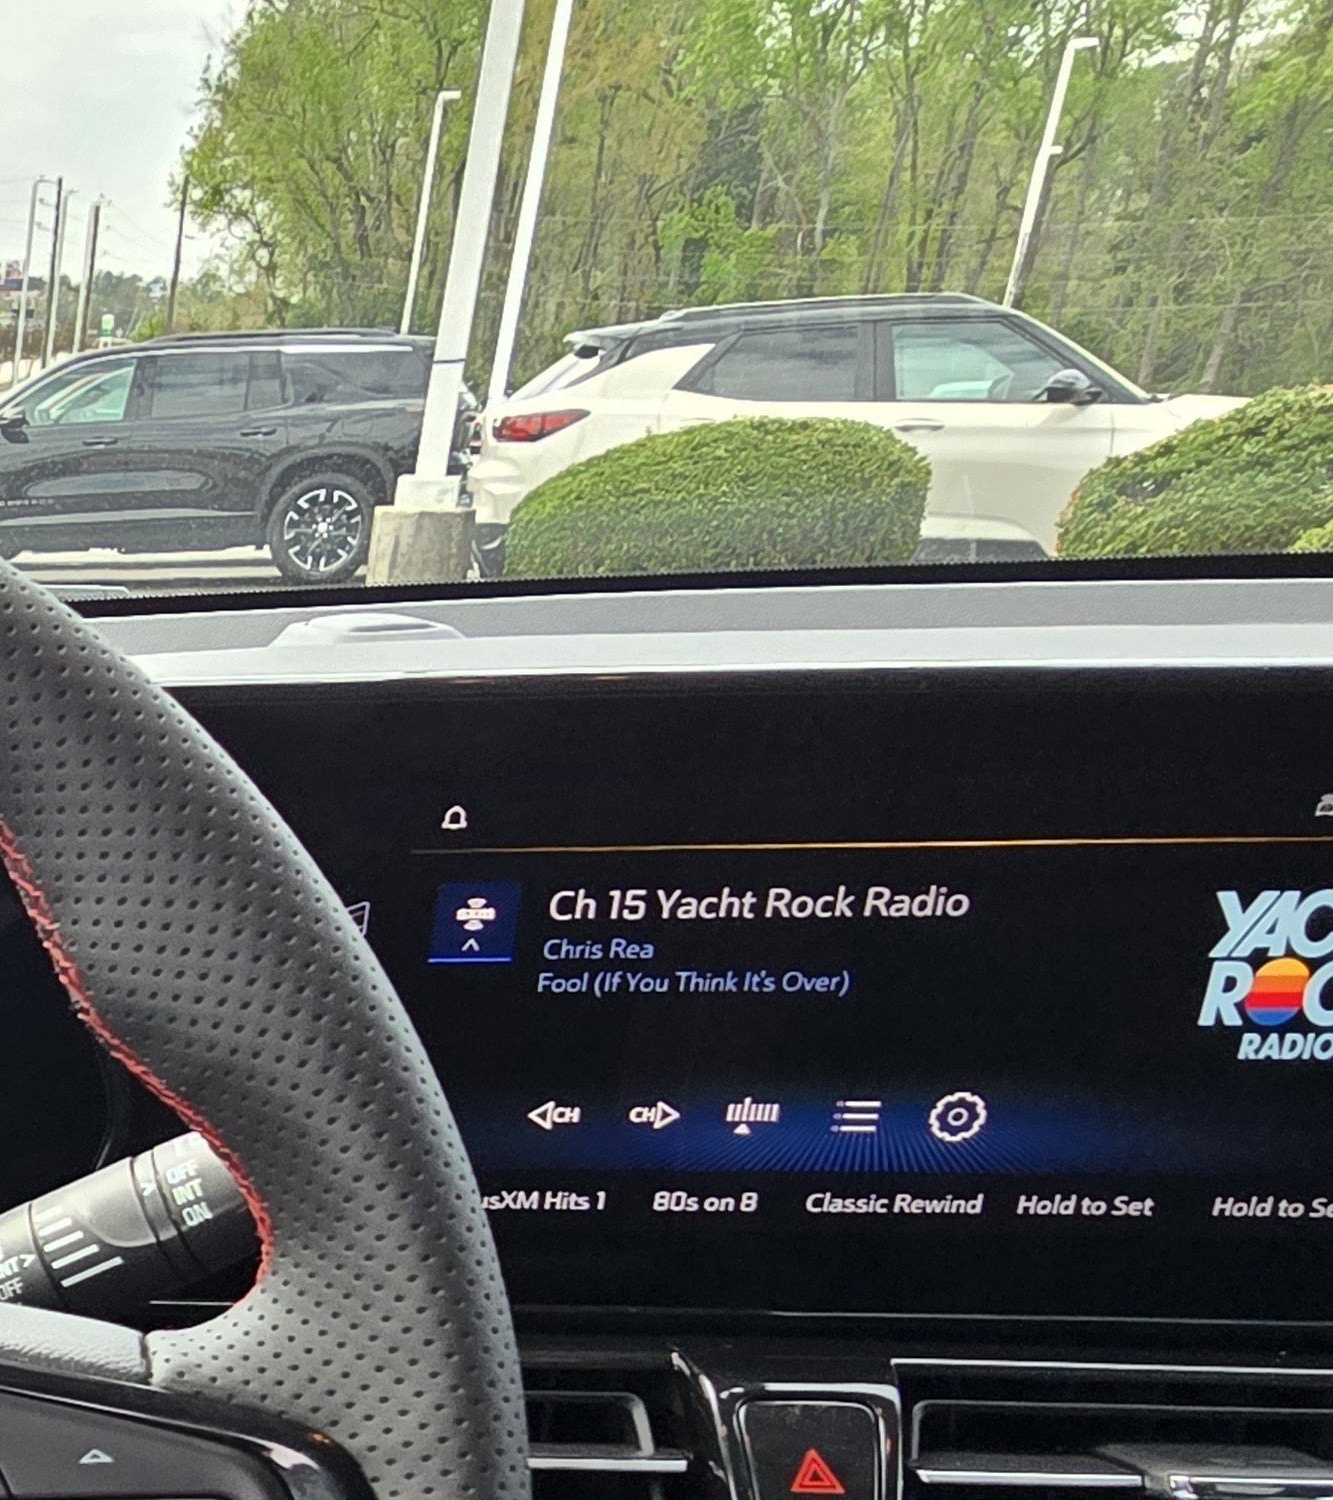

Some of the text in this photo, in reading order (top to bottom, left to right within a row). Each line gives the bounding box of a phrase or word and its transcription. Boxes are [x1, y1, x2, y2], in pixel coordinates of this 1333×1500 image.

[548, 884, 971, 921] Ch 15 Yacht Rock Radio
[543, 938, 655, 960] Chris Rea
[537, 969, 850, 997] Fool (If You Think It's Over)
[1237, 1032, 1333, 1061] RADIO
[551, 1106, 581, 1123] CH
[629, 1106, 657, 1123] CH
[166, 1160, 199, 1185] OFF
[172, 1177, 203, 1206] INT
[543, 1190, 592, 1211] Hits
[595, 1190, 607, 1210] 1
[653, 1191, 759, 1212] 80s on 8
[805, 1191, 984, 1215] Classic Rewind
[182, 1201, 213, 1227] ON
[1016, 1194, 1155, 1217] Hold to Set
[1212, 1196, 1275, 1218] Hold
[1277, 1198, 1305, 1218] to
